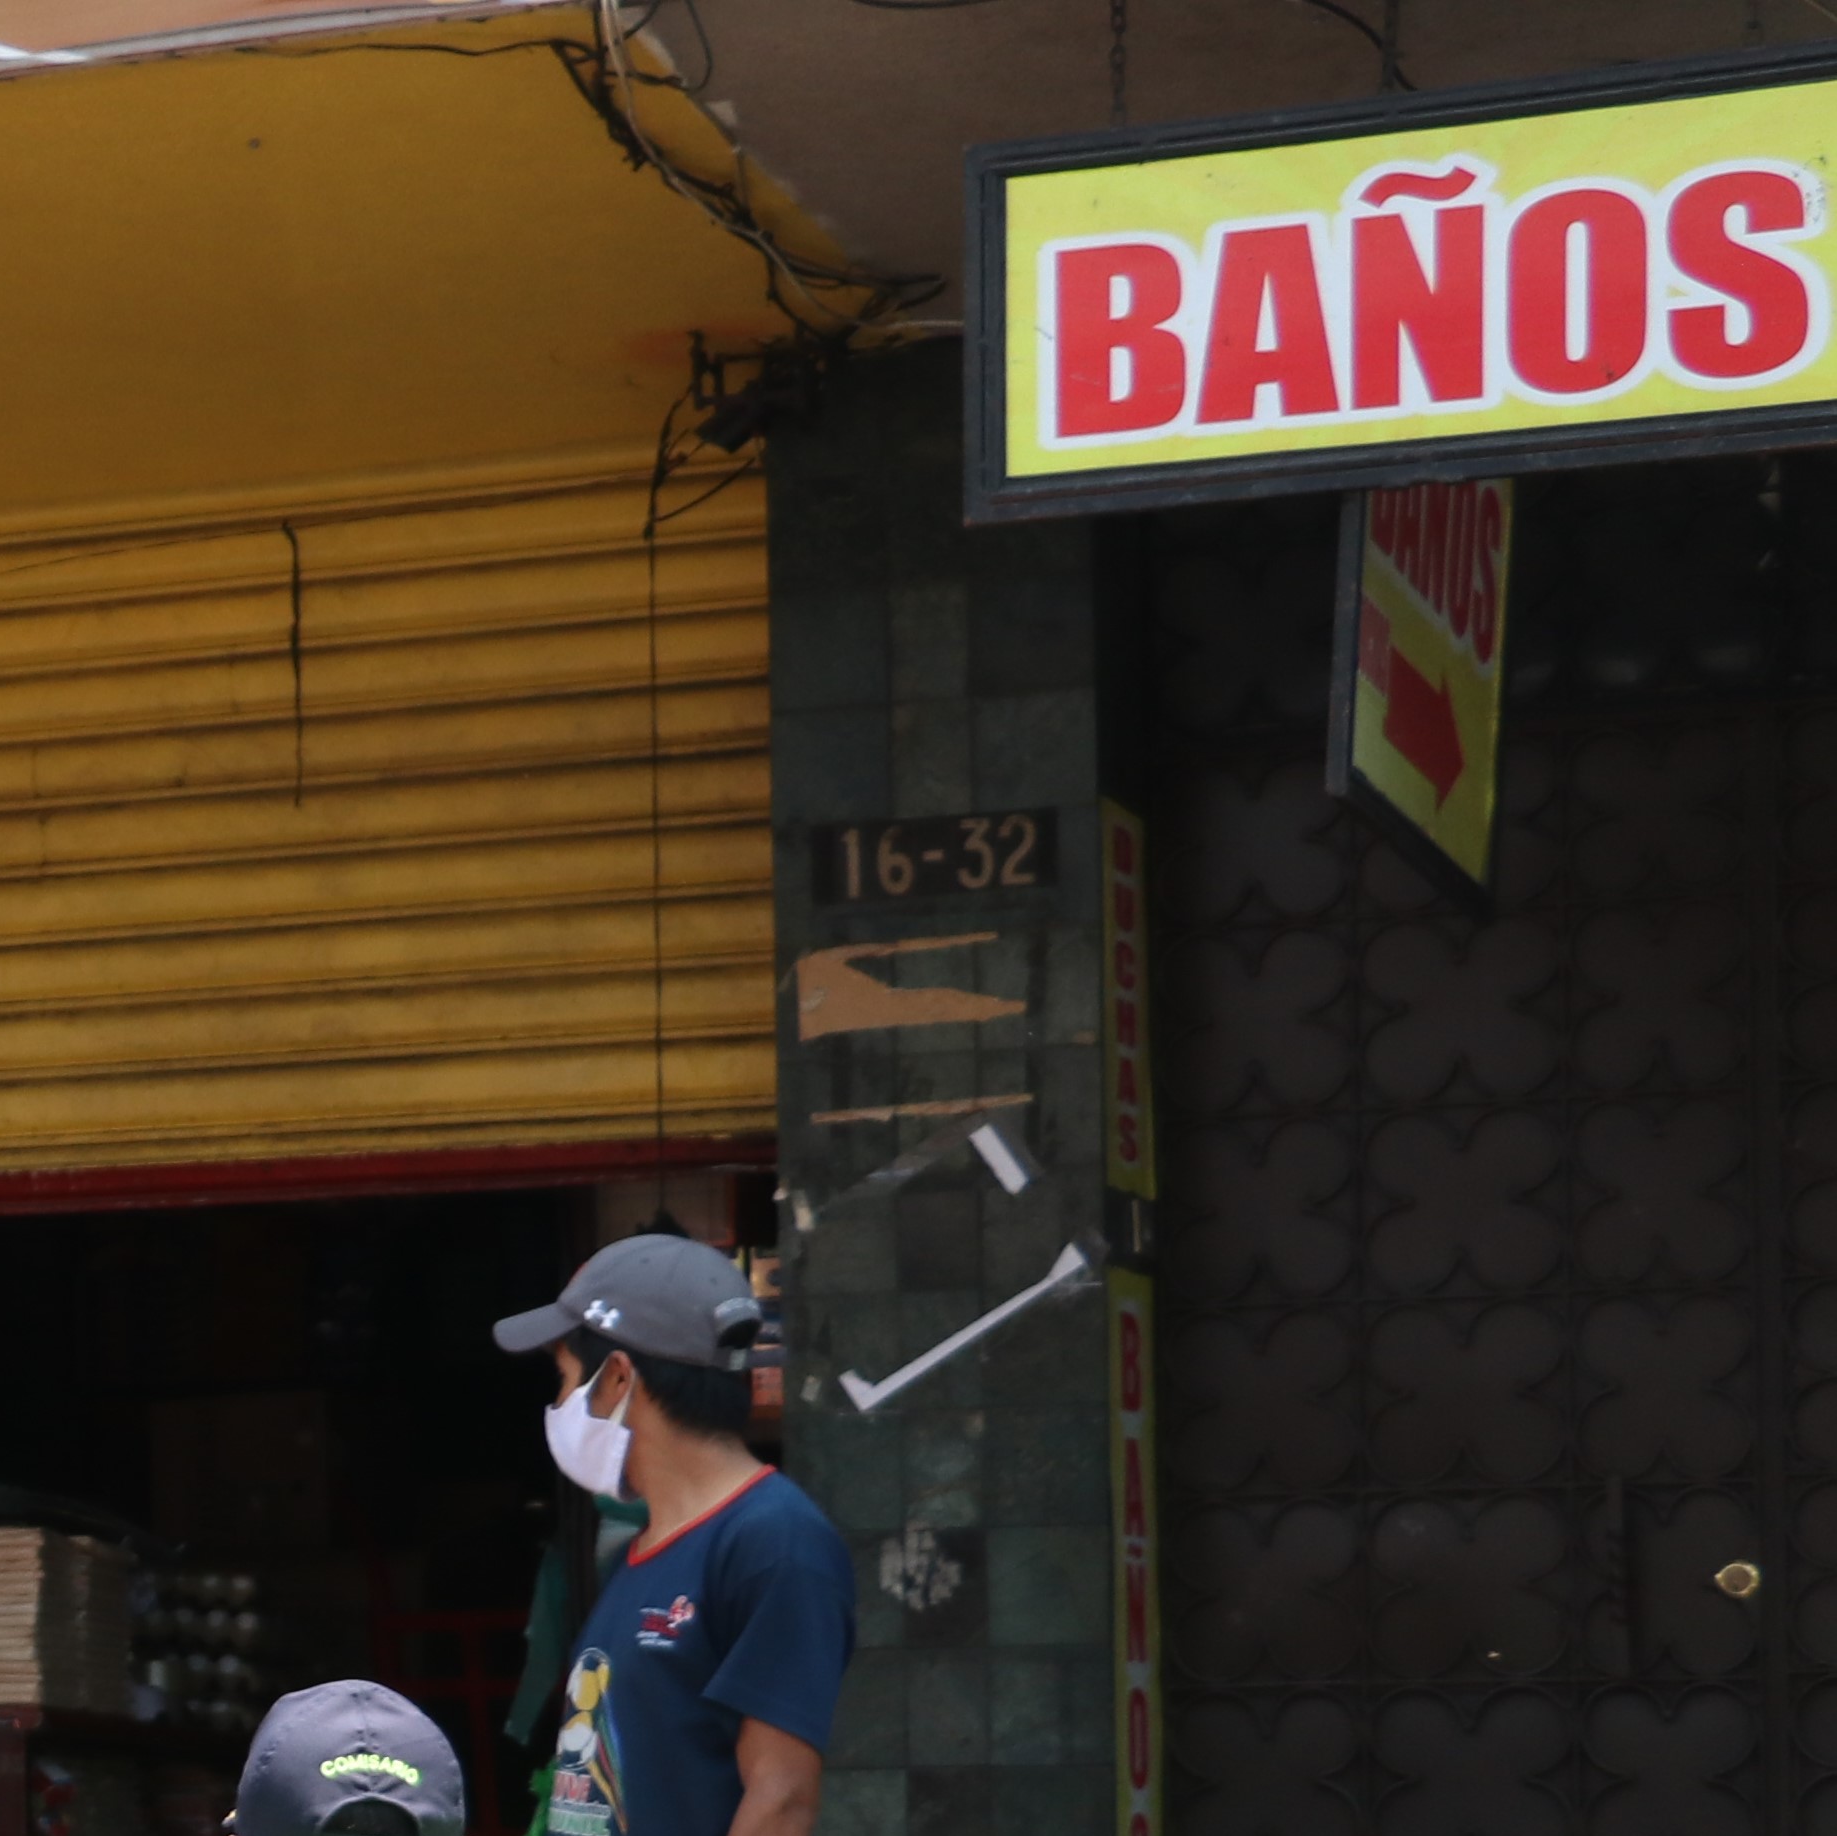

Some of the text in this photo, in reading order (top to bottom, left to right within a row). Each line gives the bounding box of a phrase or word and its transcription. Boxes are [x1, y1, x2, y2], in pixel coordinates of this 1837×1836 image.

[1053, 166, 1810, 440] BAÑOS
[839, 820, 1037, 899] 16-32
[319, 1752, 420, 1785] COMISARIO
